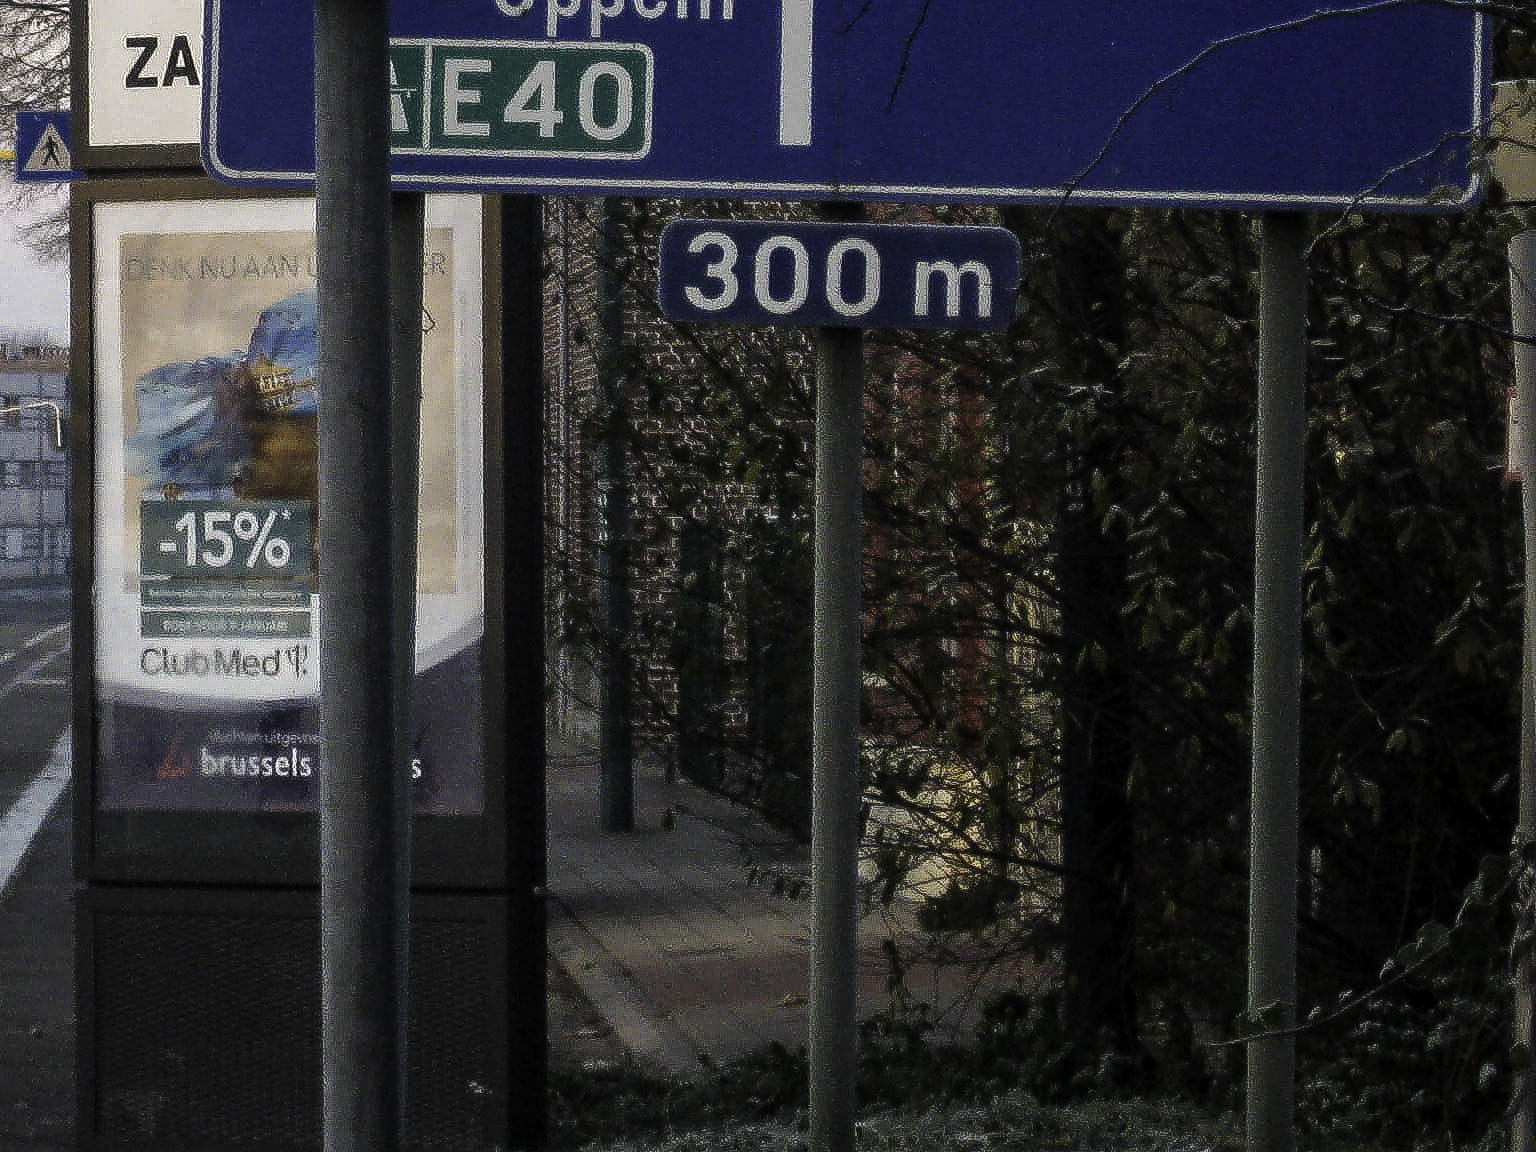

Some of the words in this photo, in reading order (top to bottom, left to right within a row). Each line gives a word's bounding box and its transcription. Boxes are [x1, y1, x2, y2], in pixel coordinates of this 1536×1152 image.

[443, 58, 633, 140] E40
[683, 232, 883, 316] 300
[914, 259, 993, 317] m
[200, 747, 312, 777] brussels
